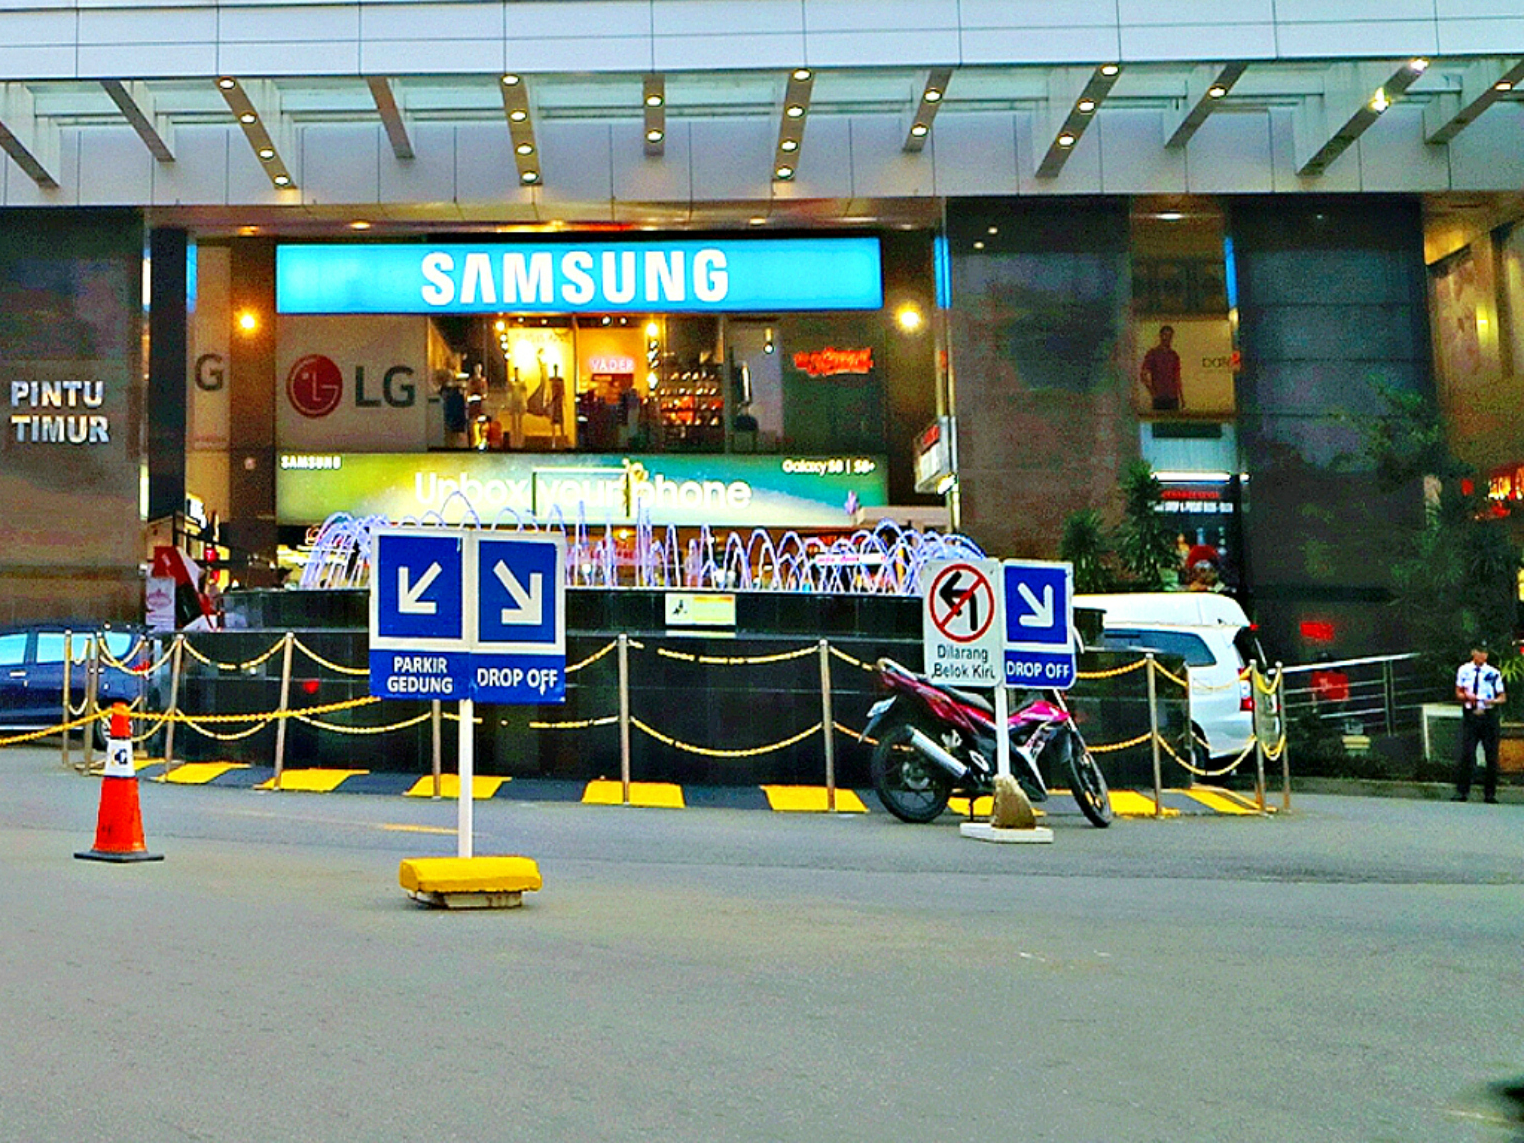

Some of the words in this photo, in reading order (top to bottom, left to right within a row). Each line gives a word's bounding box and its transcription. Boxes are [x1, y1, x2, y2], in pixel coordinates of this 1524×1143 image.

[420, 248, 729, 306] SAMSUNG
[10, 380, 105, 409] PINTU
[354, 364, 416, 408] LG
[10, 414, 111, 444] TIMUR
[782, 459, 827, 477] Galaxy
[414, 471, 529, 507] Unbox
[532, 476, 625, 516] your
[633, 474, 753, 516] phone
[936, 644, 988, 663] Dilarang
[393, 655, 448, 675] PARKIR
[933, 662, 970, 677] Belok
[1006, 660, 1043, 678] DROP
[1045, 662, 1070, 679] OFF
[386, 675, 454, 694] GEDUNG
[477, 667, 523, 688] DROP
[526, 669, 559, 689] OFF
